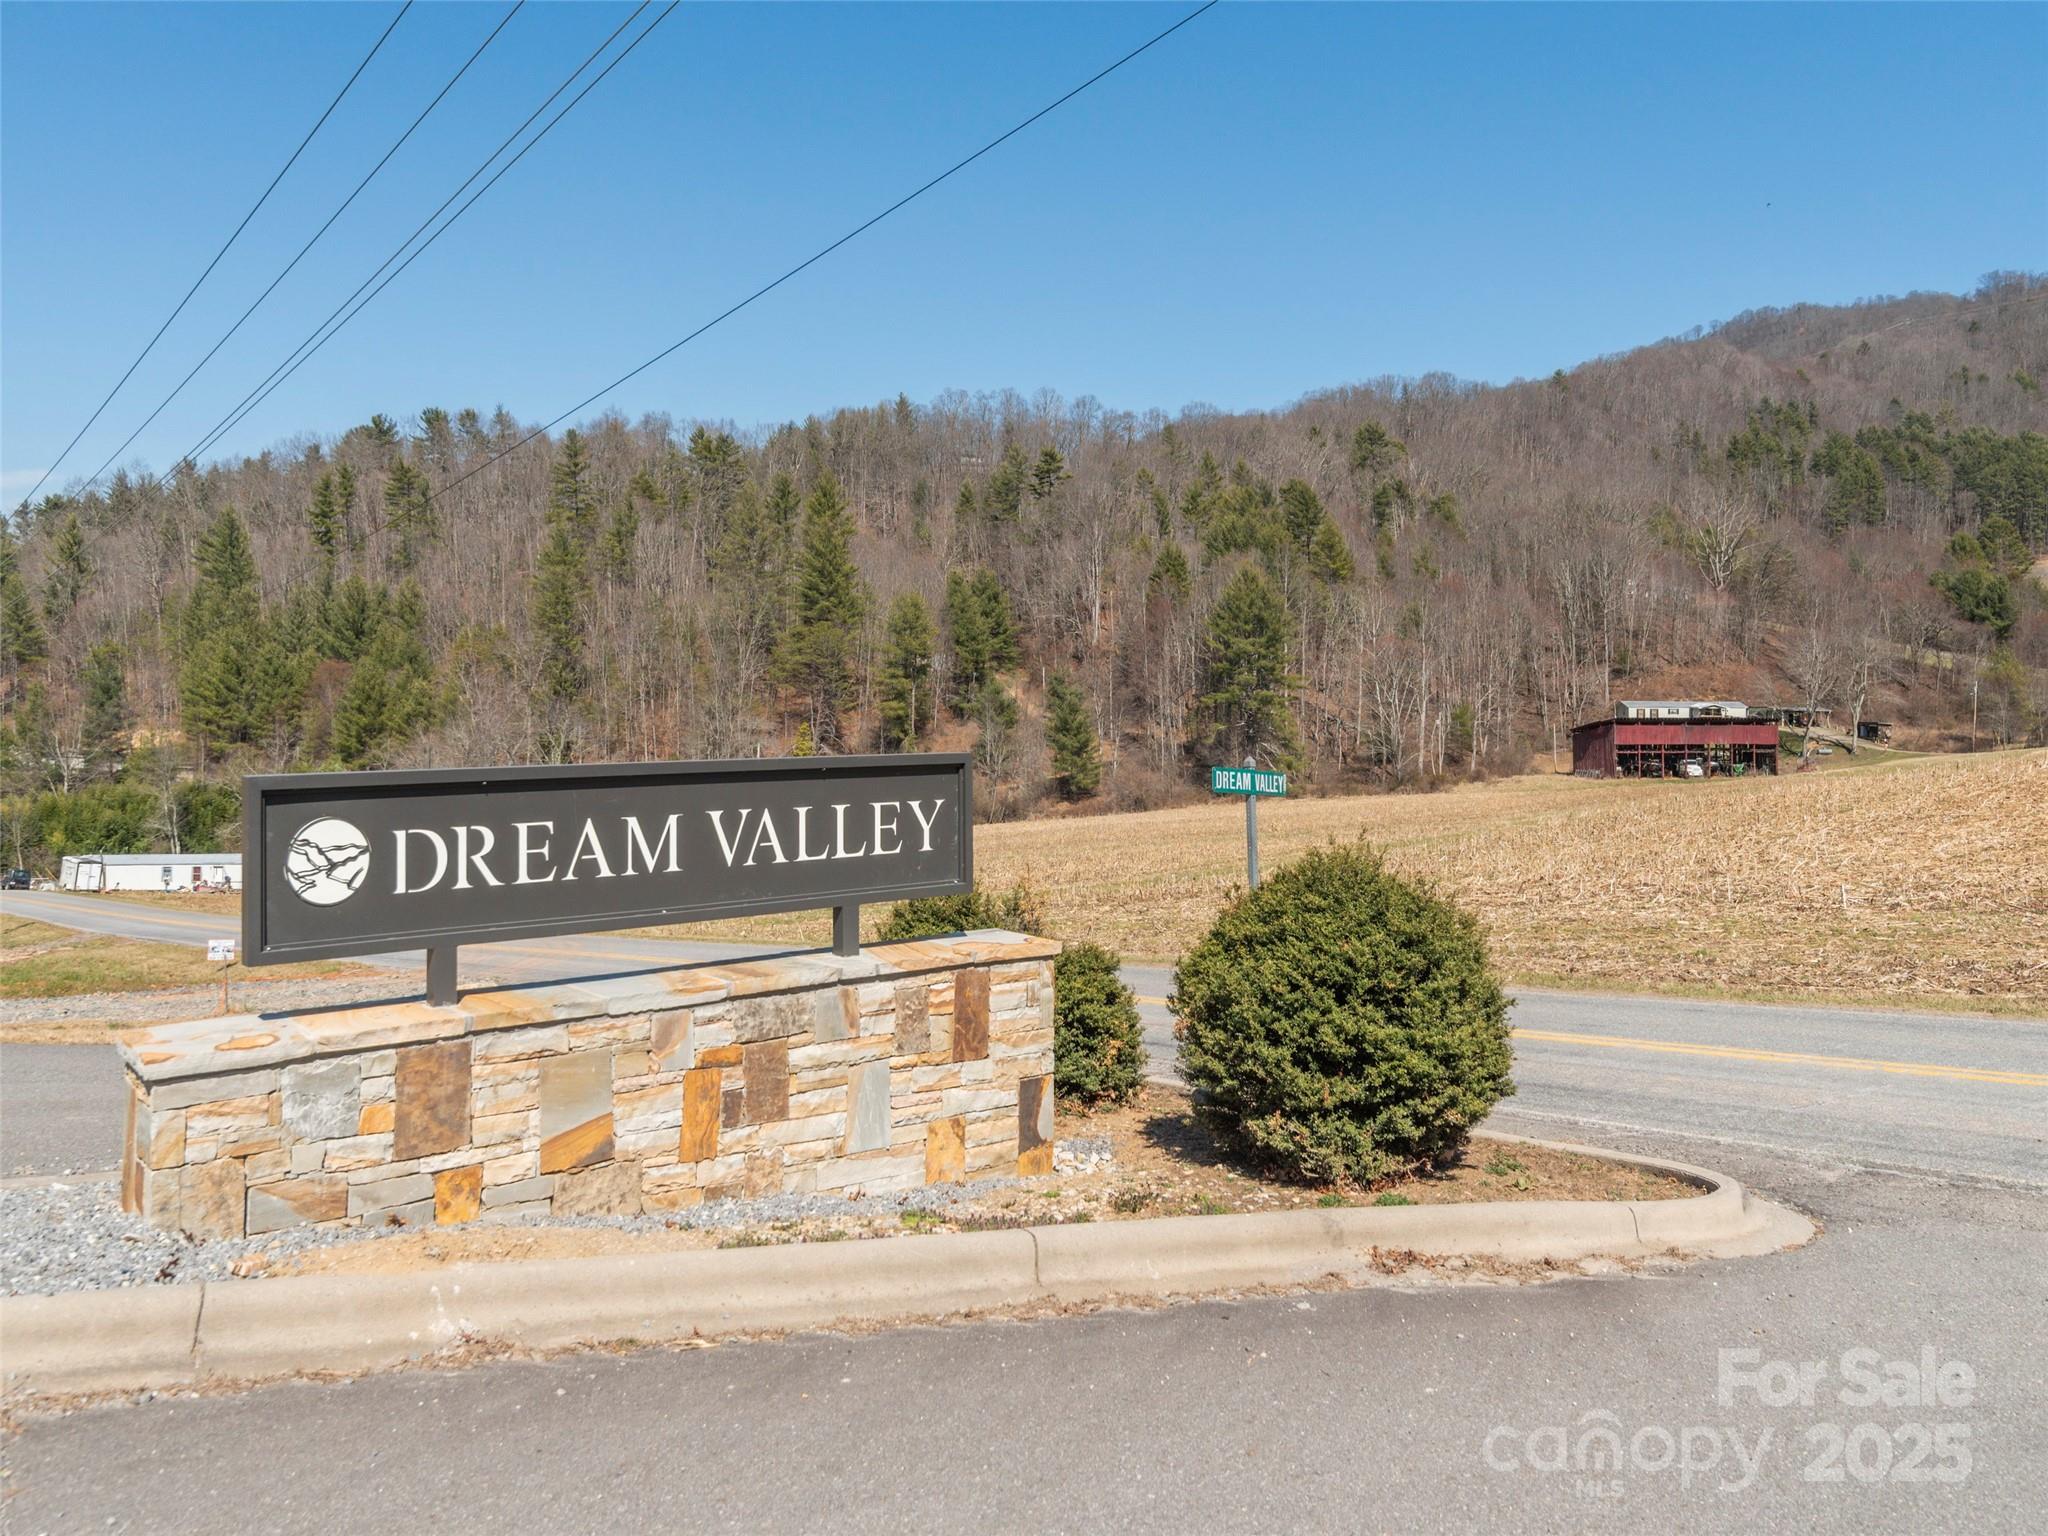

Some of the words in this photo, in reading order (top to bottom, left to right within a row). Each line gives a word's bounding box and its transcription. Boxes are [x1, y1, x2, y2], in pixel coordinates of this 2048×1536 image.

[1215, 770, 1252, 791] DREAM
[1254, 773, 1284, 794] VALLEY
[391, 812, 684, 896] DREAM
[705, 798, 946, 868] VALLEY
